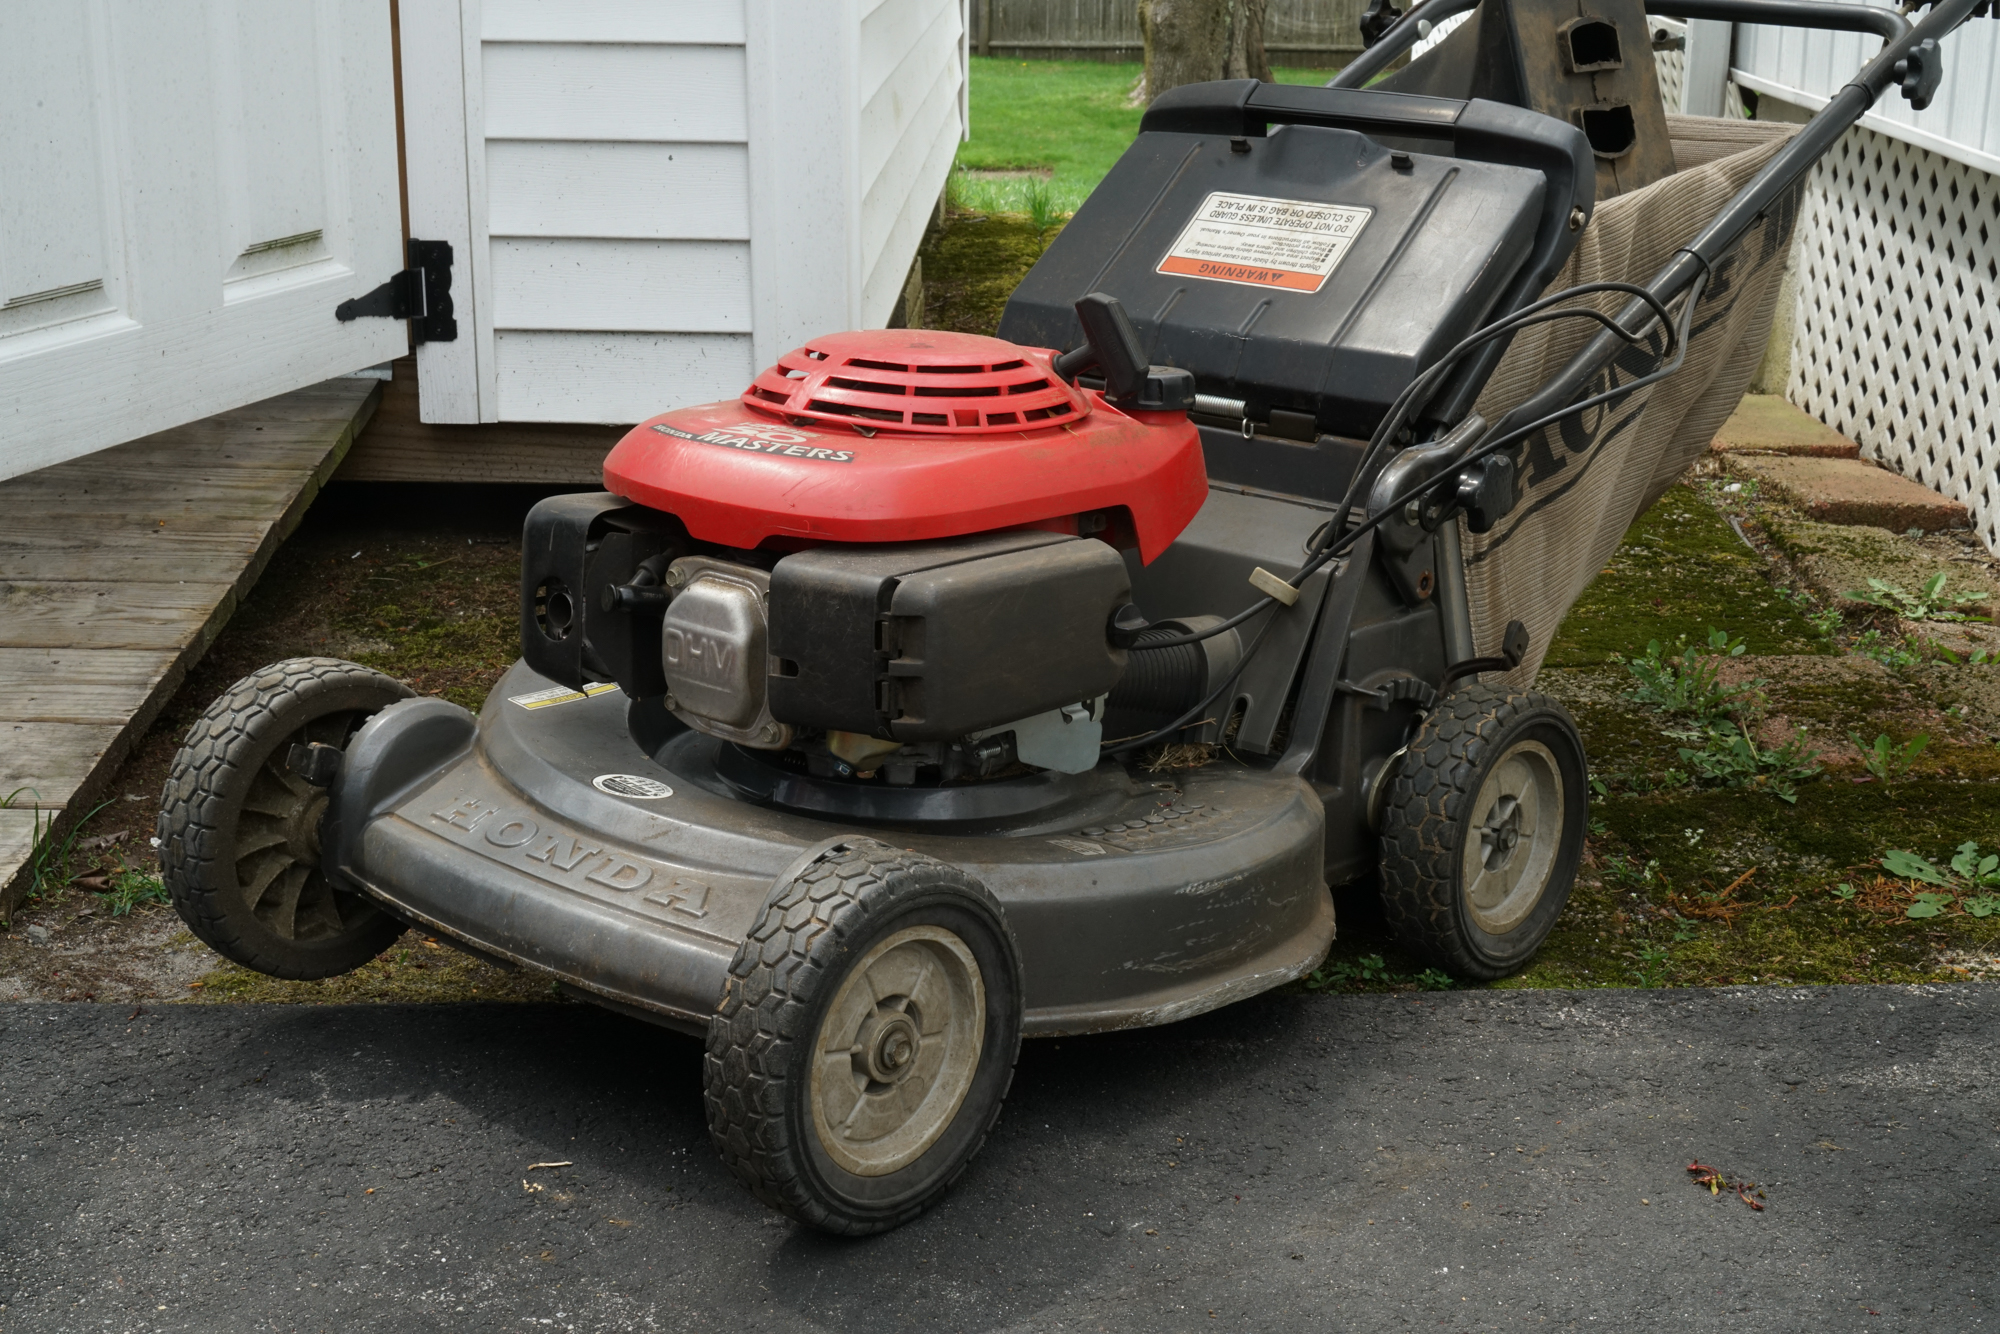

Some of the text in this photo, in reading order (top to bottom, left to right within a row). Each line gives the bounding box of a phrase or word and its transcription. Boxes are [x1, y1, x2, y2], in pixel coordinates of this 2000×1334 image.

[1215, 200, 1245, 210] PLACE
[1245, 203, 1257, 212] IN
[1269, 206, 1289, 215] BAG
[1290, 209, 1304, 218] OR
[1306, 211, 1343, 221] CLOSED
[1344, 215, 1355, 223] IS
[1210, 210, 1349, 233] DO NOT OPERATE UNLESS GUARD
[1268, 236, 1302, 244] instructions
[1299, 263, 1321, 271] Objects
[1198, 264, 1269, 281] WARNING
[711, 426, 806, 443] 50
[653, 424, 854, 462] HONDA MASTERS
[664, 626, 735, 680] OHV
[431, 797, 710, 918] HONDA
